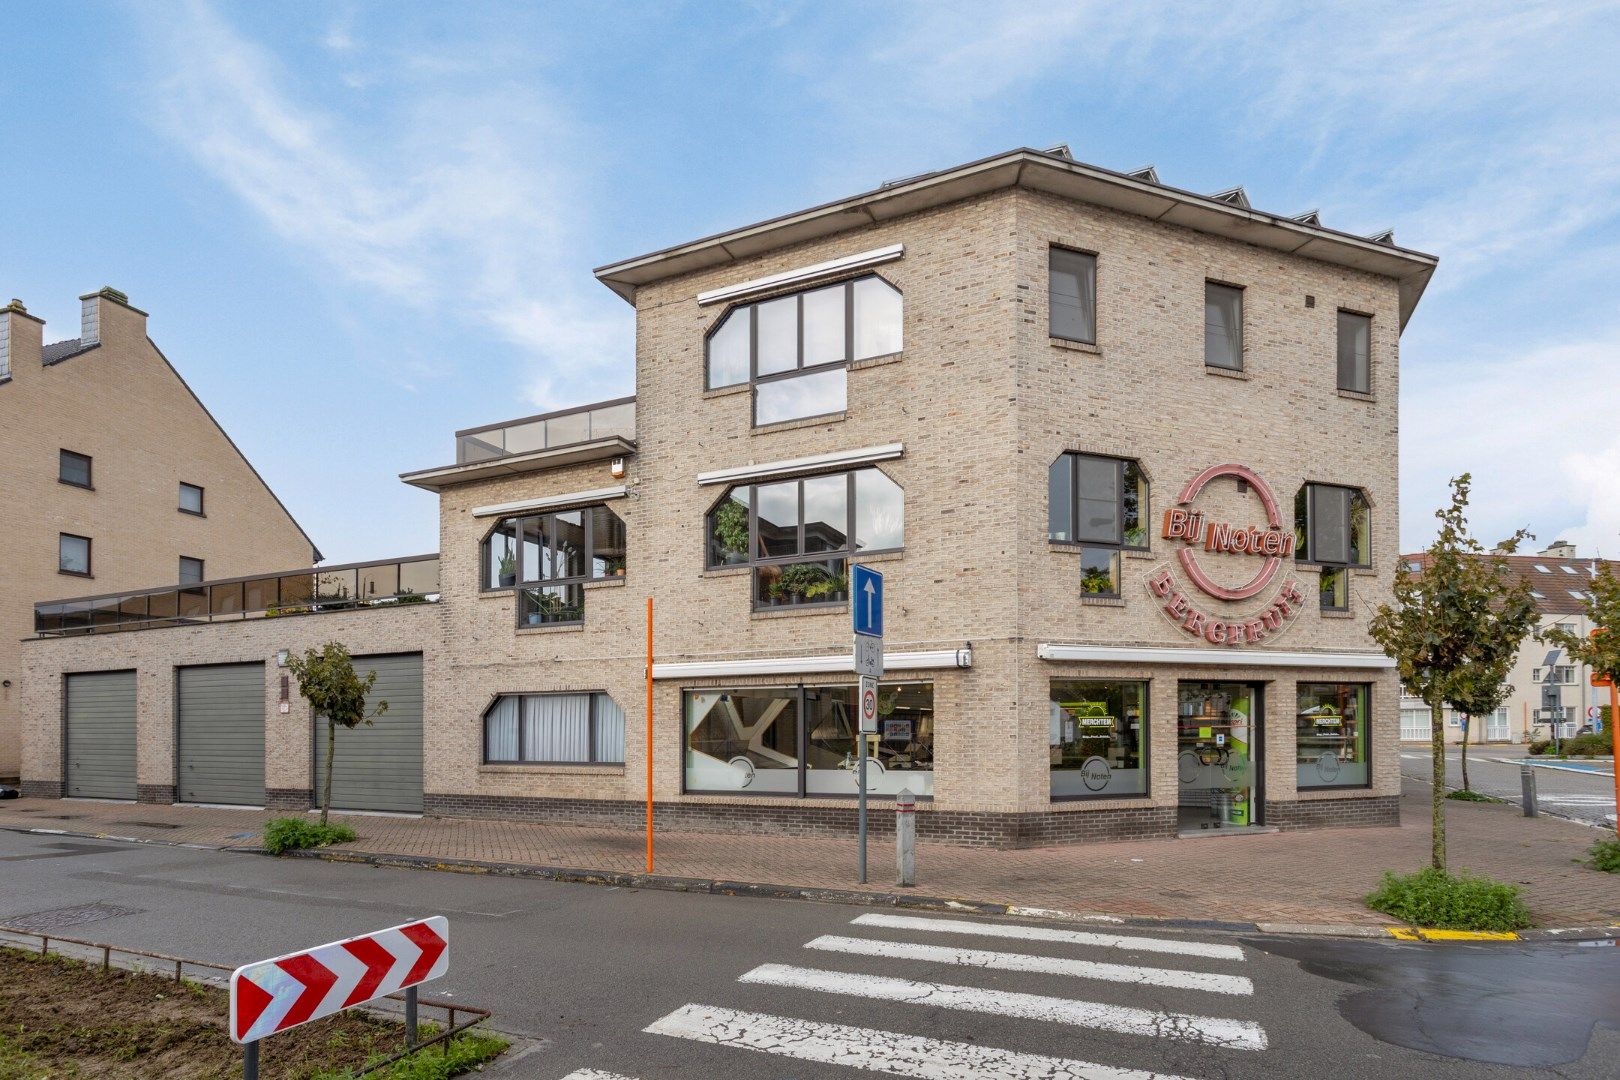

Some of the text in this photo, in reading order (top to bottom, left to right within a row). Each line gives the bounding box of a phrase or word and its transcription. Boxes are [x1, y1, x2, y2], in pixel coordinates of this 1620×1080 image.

[1163, 508, 1297, 556] Bij Noten
[865, 698, 873, 711] 30
[1091, 772, 1112, 781] Noten
